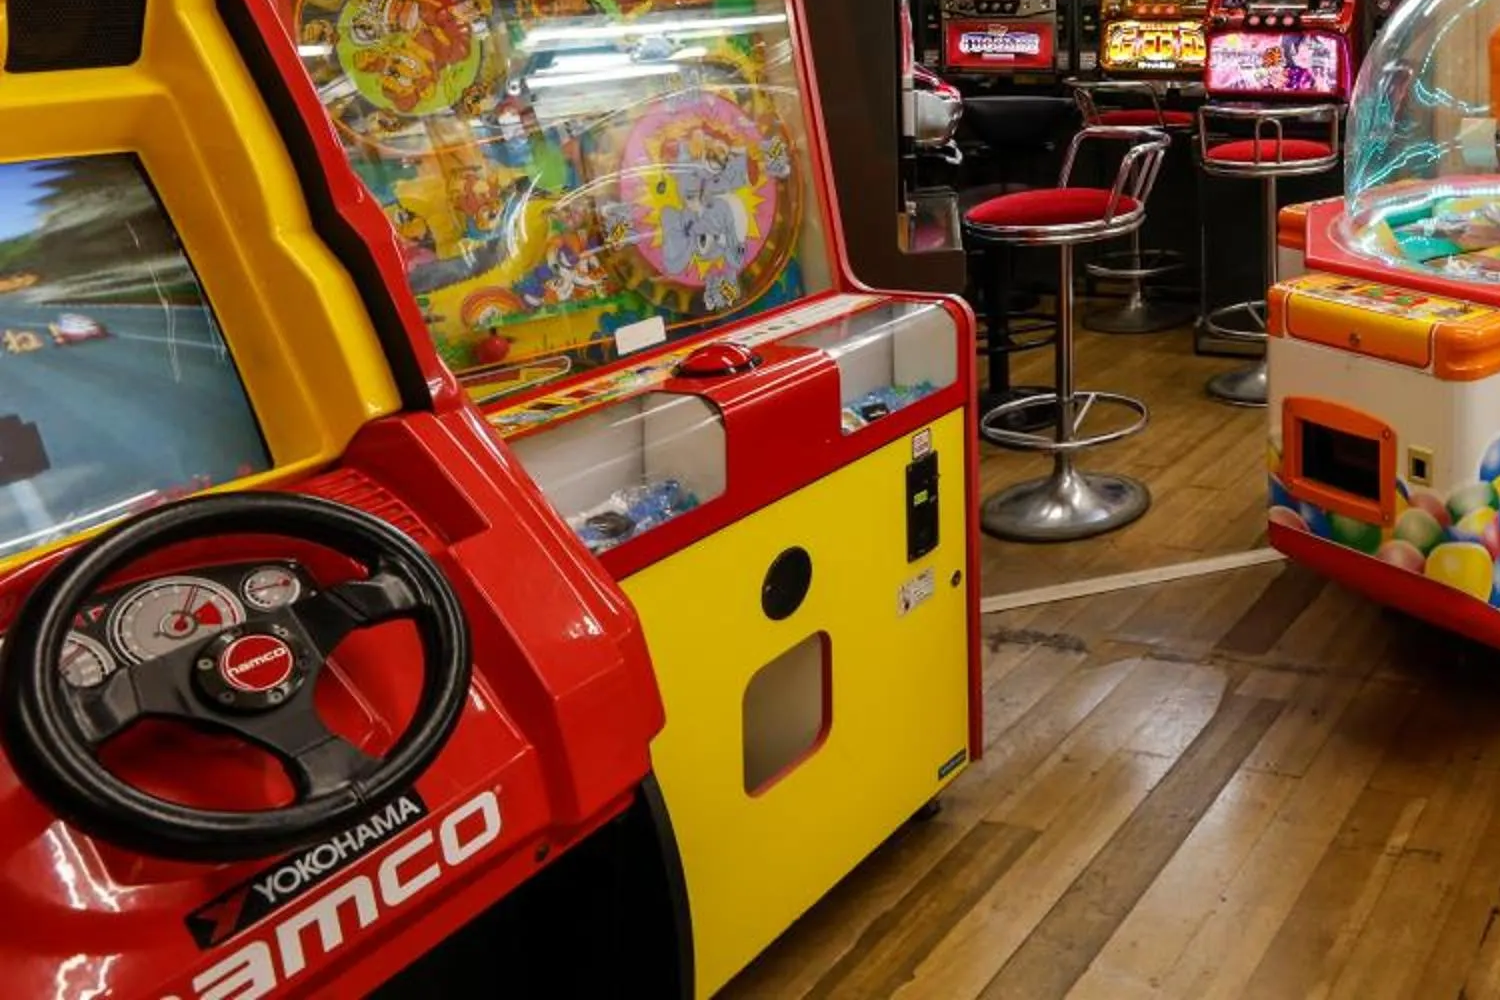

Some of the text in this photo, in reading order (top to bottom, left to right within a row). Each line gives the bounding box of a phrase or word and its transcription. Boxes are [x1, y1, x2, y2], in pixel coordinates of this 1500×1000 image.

[228, 647, 288, 677] namco
[155, 790, 502, 1000] amco
[253, 796, 422, 903] YOKOHAMA
